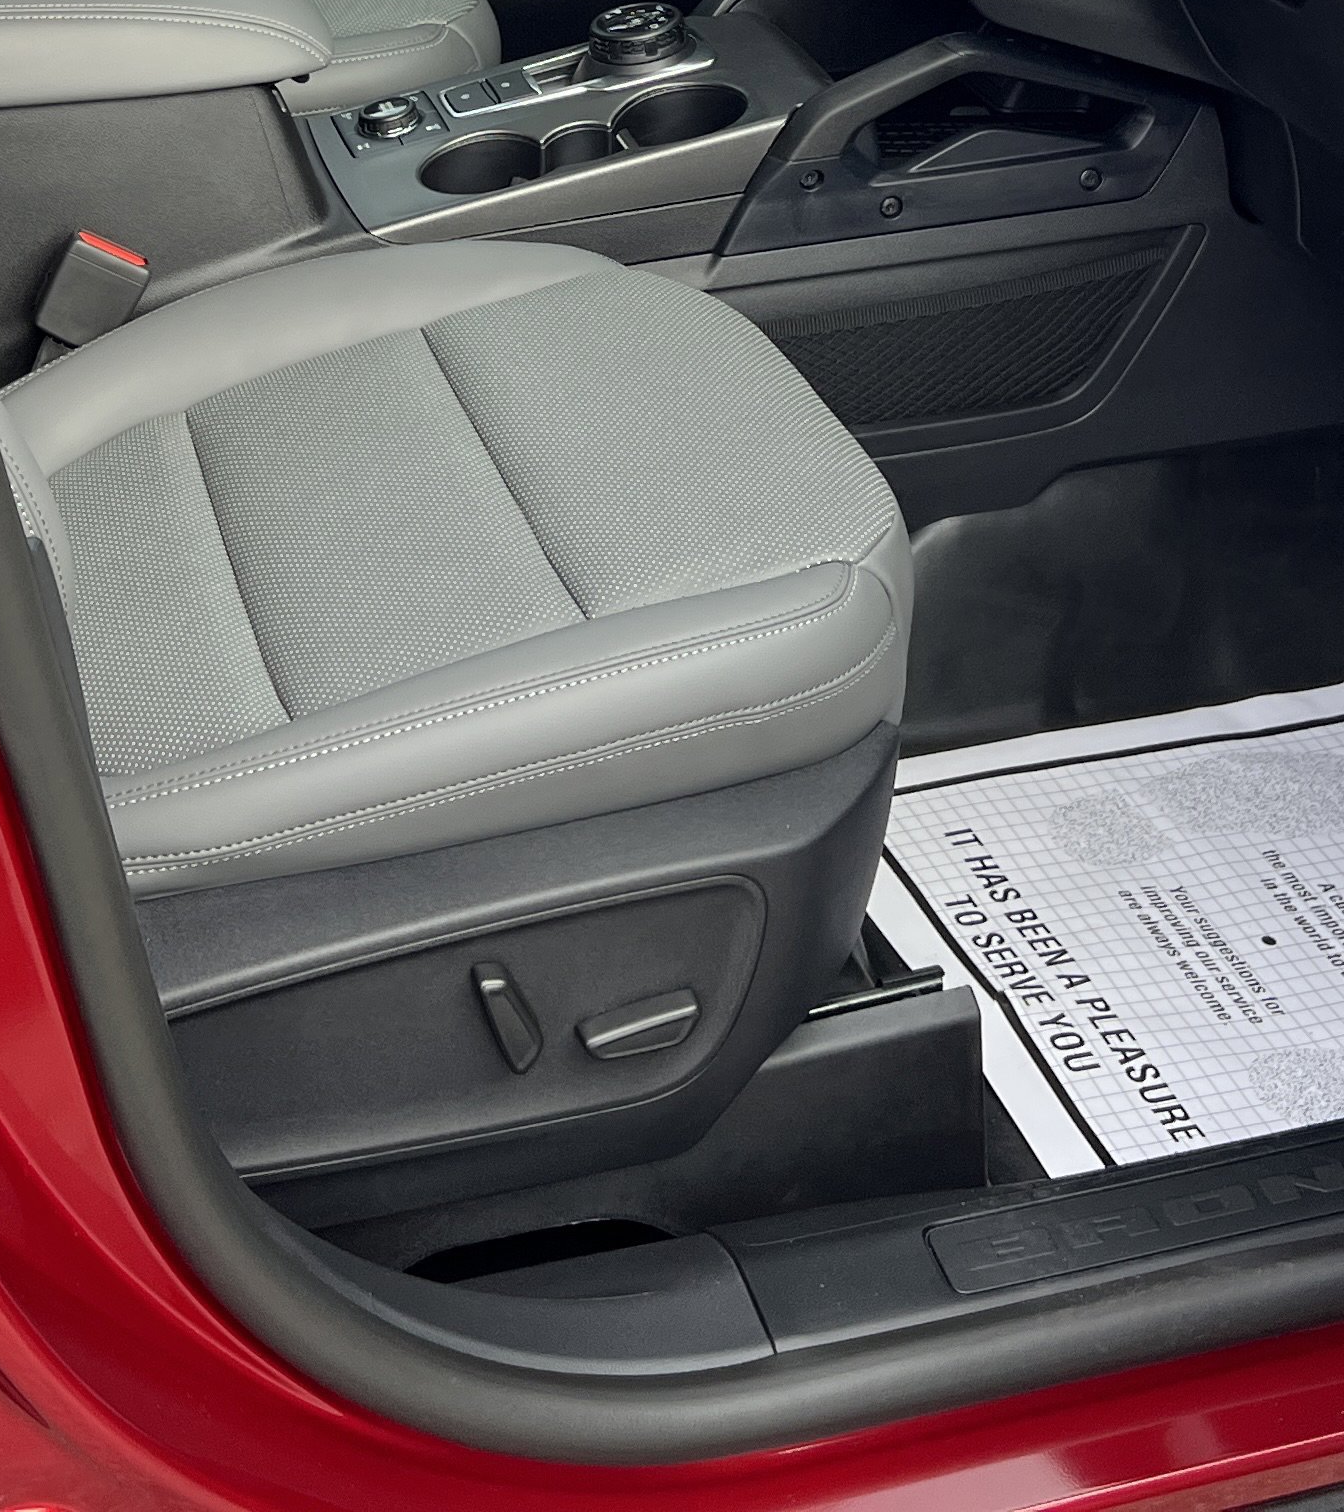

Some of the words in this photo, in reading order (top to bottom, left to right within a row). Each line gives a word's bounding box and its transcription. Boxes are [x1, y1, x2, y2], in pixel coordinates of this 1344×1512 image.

[943, 828, 984, 847] IT
[963, 854, 1021, 903] HAS
[1262, 850, 1286, 869] the
[1280, 872, 1318, 902] most
[1317, 883, 1336, 893] A
[1006, 908, 1075, 967] BEEN
[1118, 889, 1142, 910] are
[1137, 914, 1181, 957] always
[1169, 886, 1200, 915] Your
[1194, 917, 1266, 994] suggestions
[1261, 996, 1286, 1015] for
[1260, 878, 1278, 890] in
[1274, 893, 1297, 912] the
[1294, 916, 1335, 951] world
[1328, 953, 1344, 967] to
[944, 893, 988, 927] TO
[972, 932, 1055, 1007] SERVE
[1038, 1013, 1101, 1073] YOU
[1056, 973, 1091, 989] A
[1141, 886, 1201, 948] improving
[1195, 951, 1221, 973] our
[1215, 976, 1263, 1024] service
[1076, 997, 1207, 1143] PLEASURE
